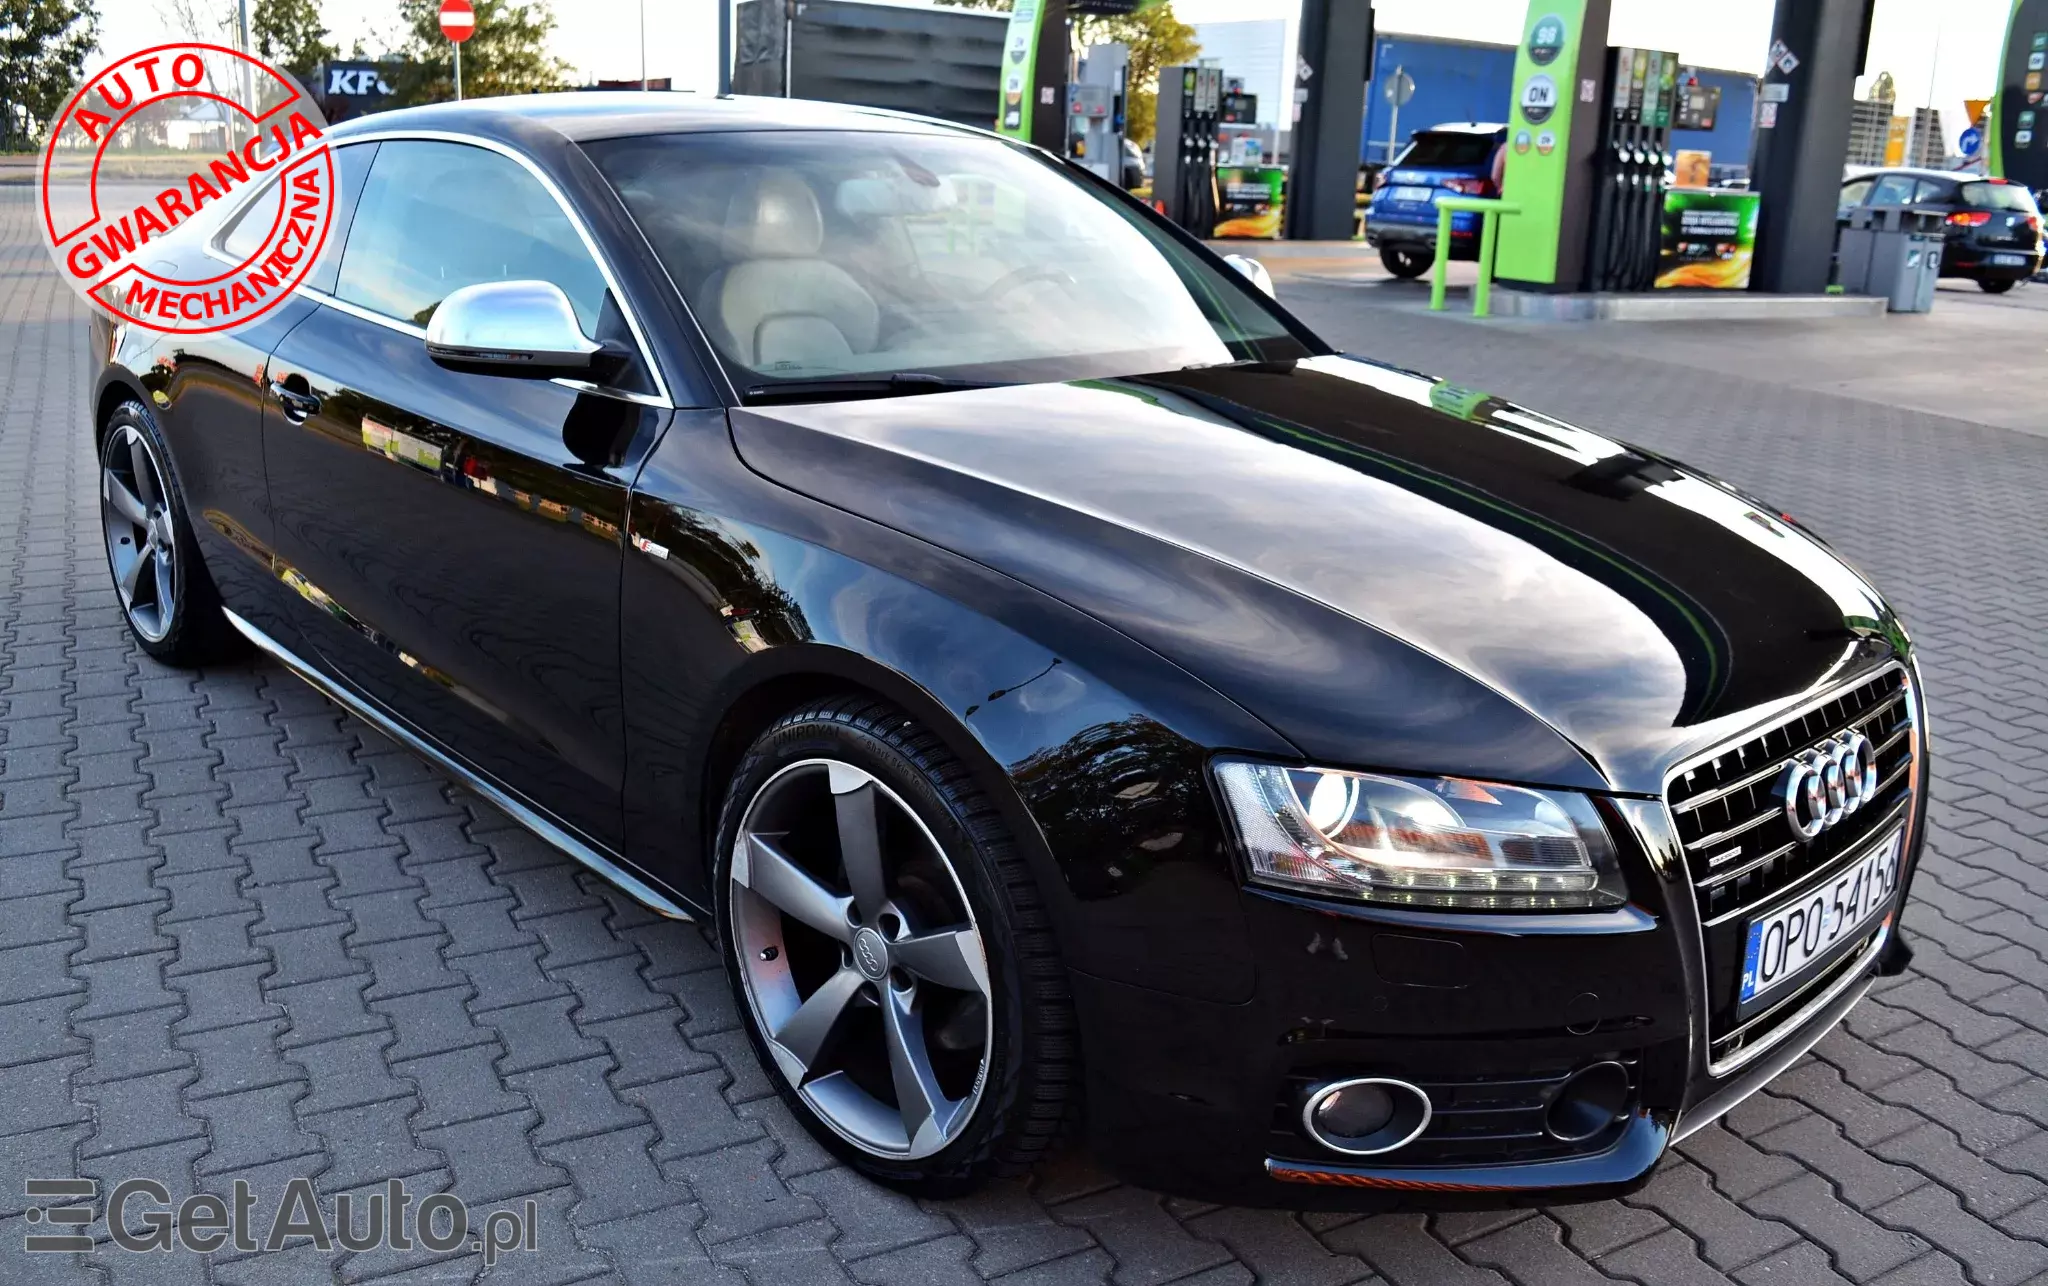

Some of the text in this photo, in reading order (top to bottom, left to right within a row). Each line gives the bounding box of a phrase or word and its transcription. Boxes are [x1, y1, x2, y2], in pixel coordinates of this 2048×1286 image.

[1528, 87, 1549, 102] ON
[773, 724, 840, 749] UNIROYAL
[1761, 833, 1900, 983] OPO 54156
[1742, 970, 1755, 992] PL
